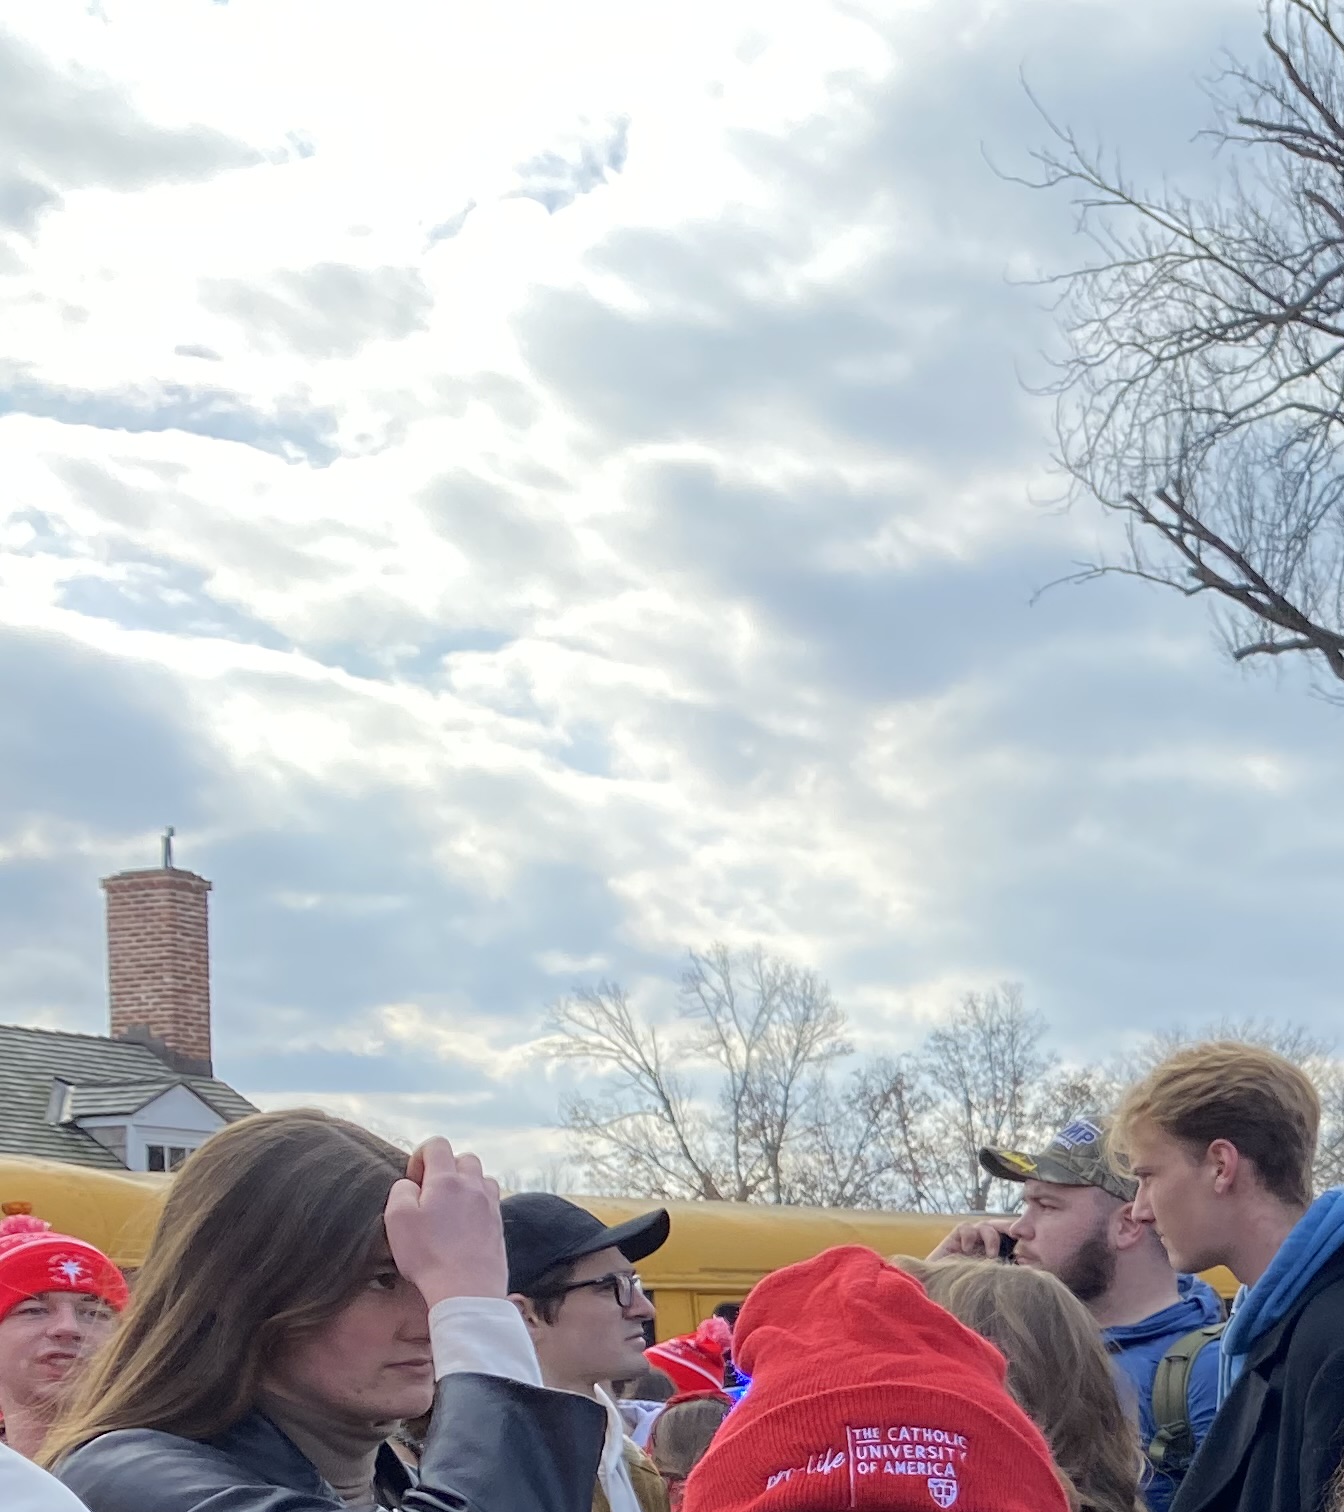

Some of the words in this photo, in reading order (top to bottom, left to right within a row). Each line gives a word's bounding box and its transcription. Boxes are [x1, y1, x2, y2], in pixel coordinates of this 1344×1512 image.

[852, 1427, 880, 1439] THE
[887, 1427, 968, 1448] CATHOLIC
[856, 1444, 967, 1462] UNIVERSITY
[857, 1461, 878, 1475] OF
[883, 1461, 956, 1478] AMERICA
